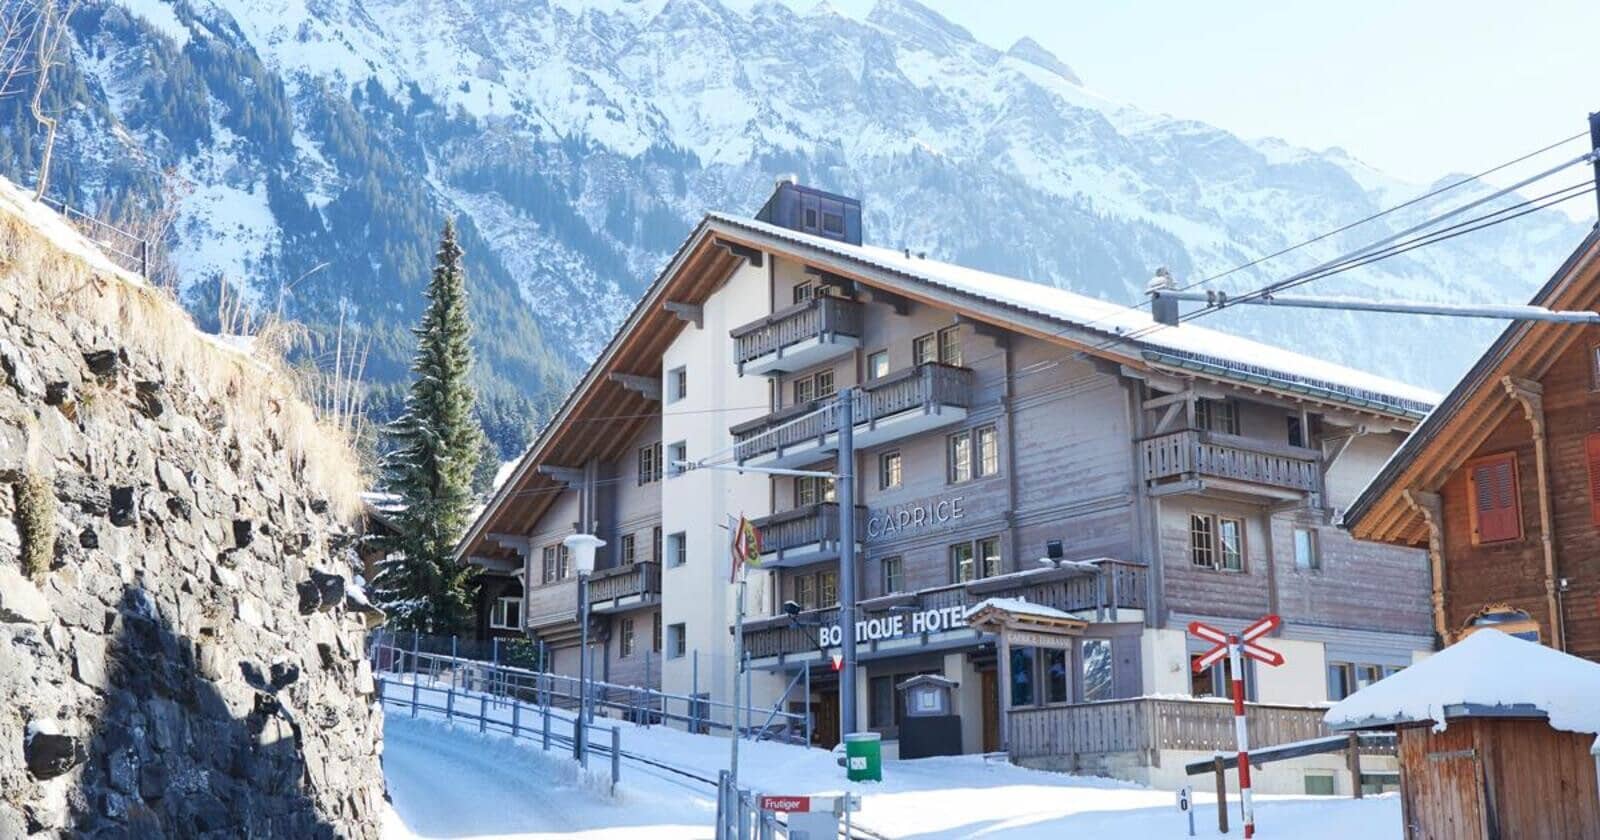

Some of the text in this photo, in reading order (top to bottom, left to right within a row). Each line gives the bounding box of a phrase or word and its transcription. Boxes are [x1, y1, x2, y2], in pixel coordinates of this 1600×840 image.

[867, 497, 964, 537] CAPRICE
[819, 615, 904, 648] BOTIQUE
[765, 798, 800, 809] Frutiger
